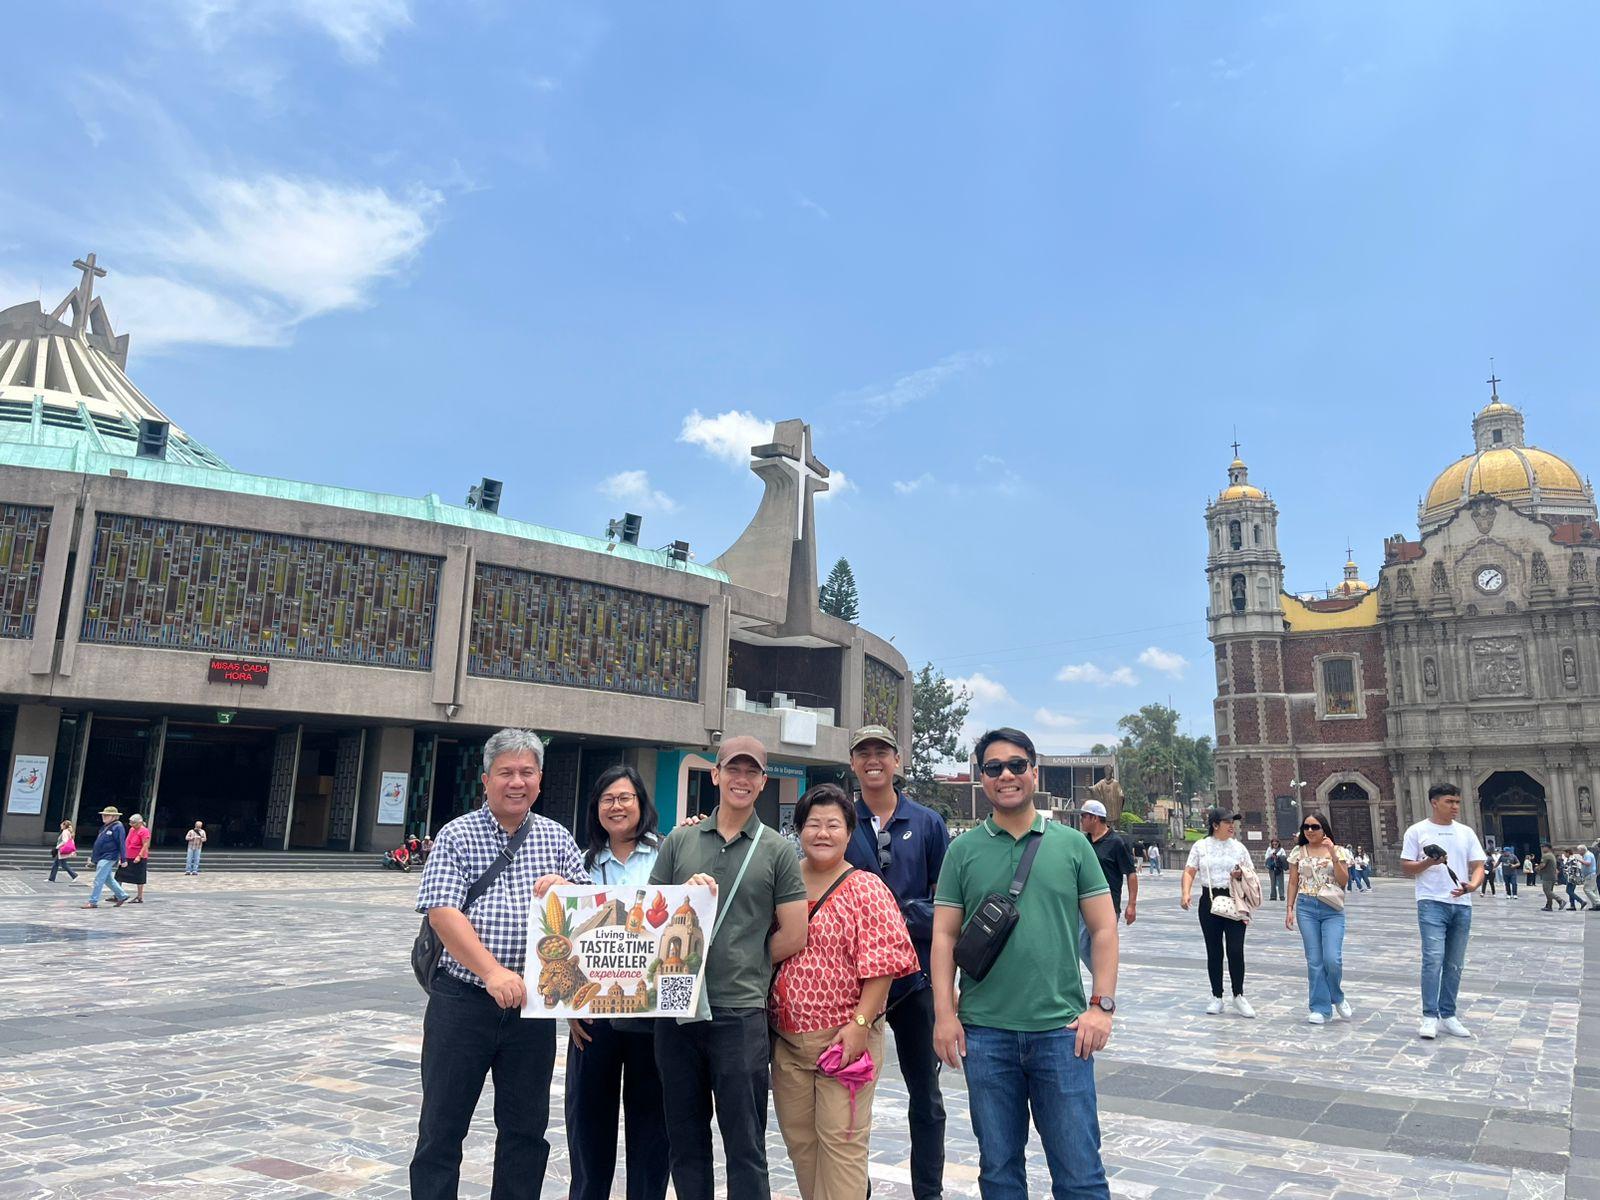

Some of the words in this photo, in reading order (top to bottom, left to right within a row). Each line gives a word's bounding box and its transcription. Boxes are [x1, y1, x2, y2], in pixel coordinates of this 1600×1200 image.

[211, 662, 240, 671] MISAS
[243, 663, 268, 673] CADA
[224, 672, 253, 680] HORA
[220, 713, 230, 724] 3
[595, 930, 625, 941] Living
[585, 955, 647, 968] TRAVELER
[589, 969, 642, 980] experience
